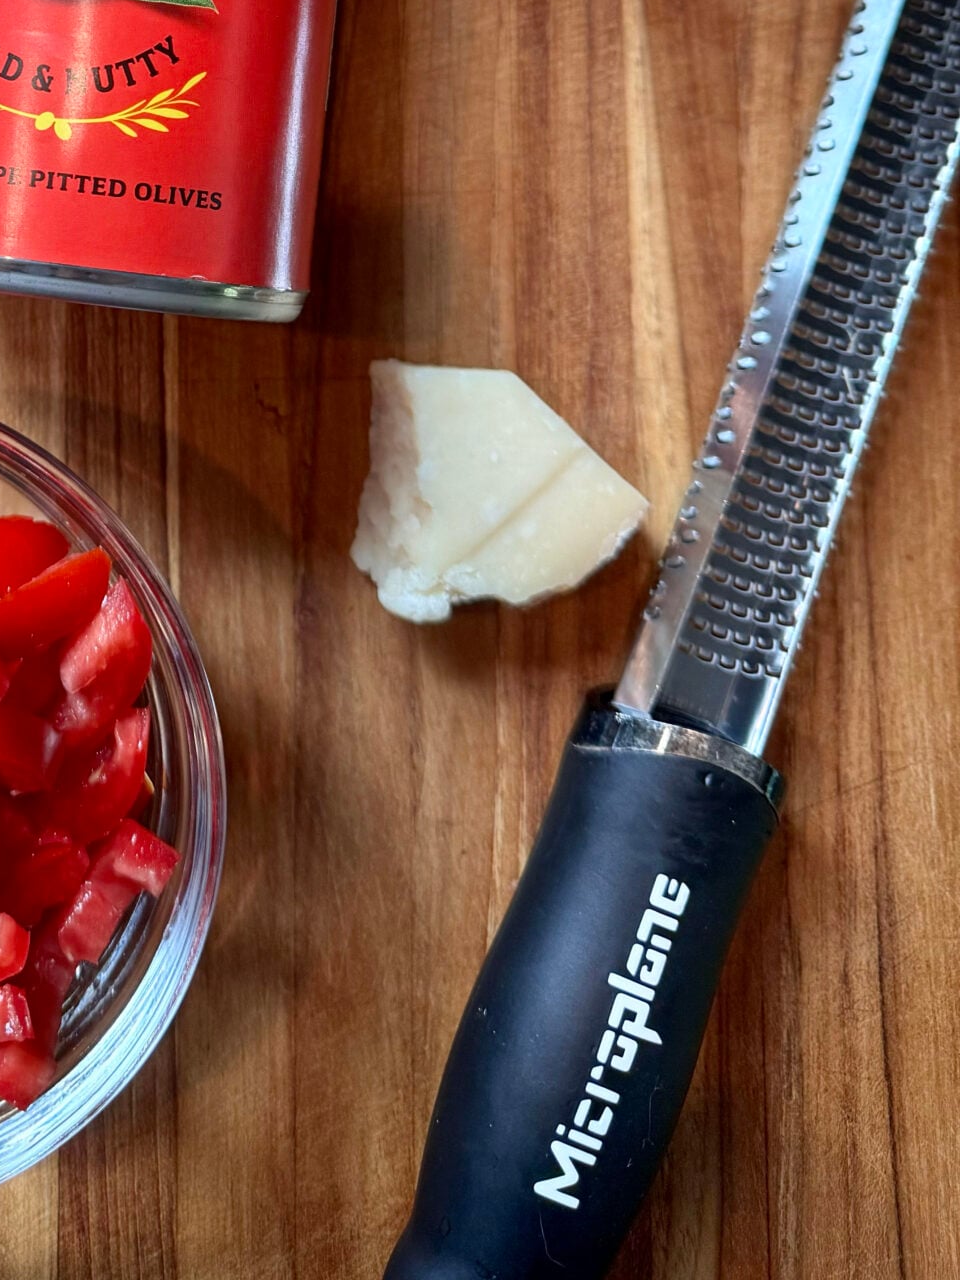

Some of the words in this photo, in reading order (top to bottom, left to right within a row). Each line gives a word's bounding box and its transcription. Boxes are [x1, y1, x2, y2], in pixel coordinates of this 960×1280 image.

[31, 64, 54, 93] &
[28, 169, 127, 199] PITTED
[133, 182, 223, 211] OLIVES
[533, 873, 691, 1209] Microplane
